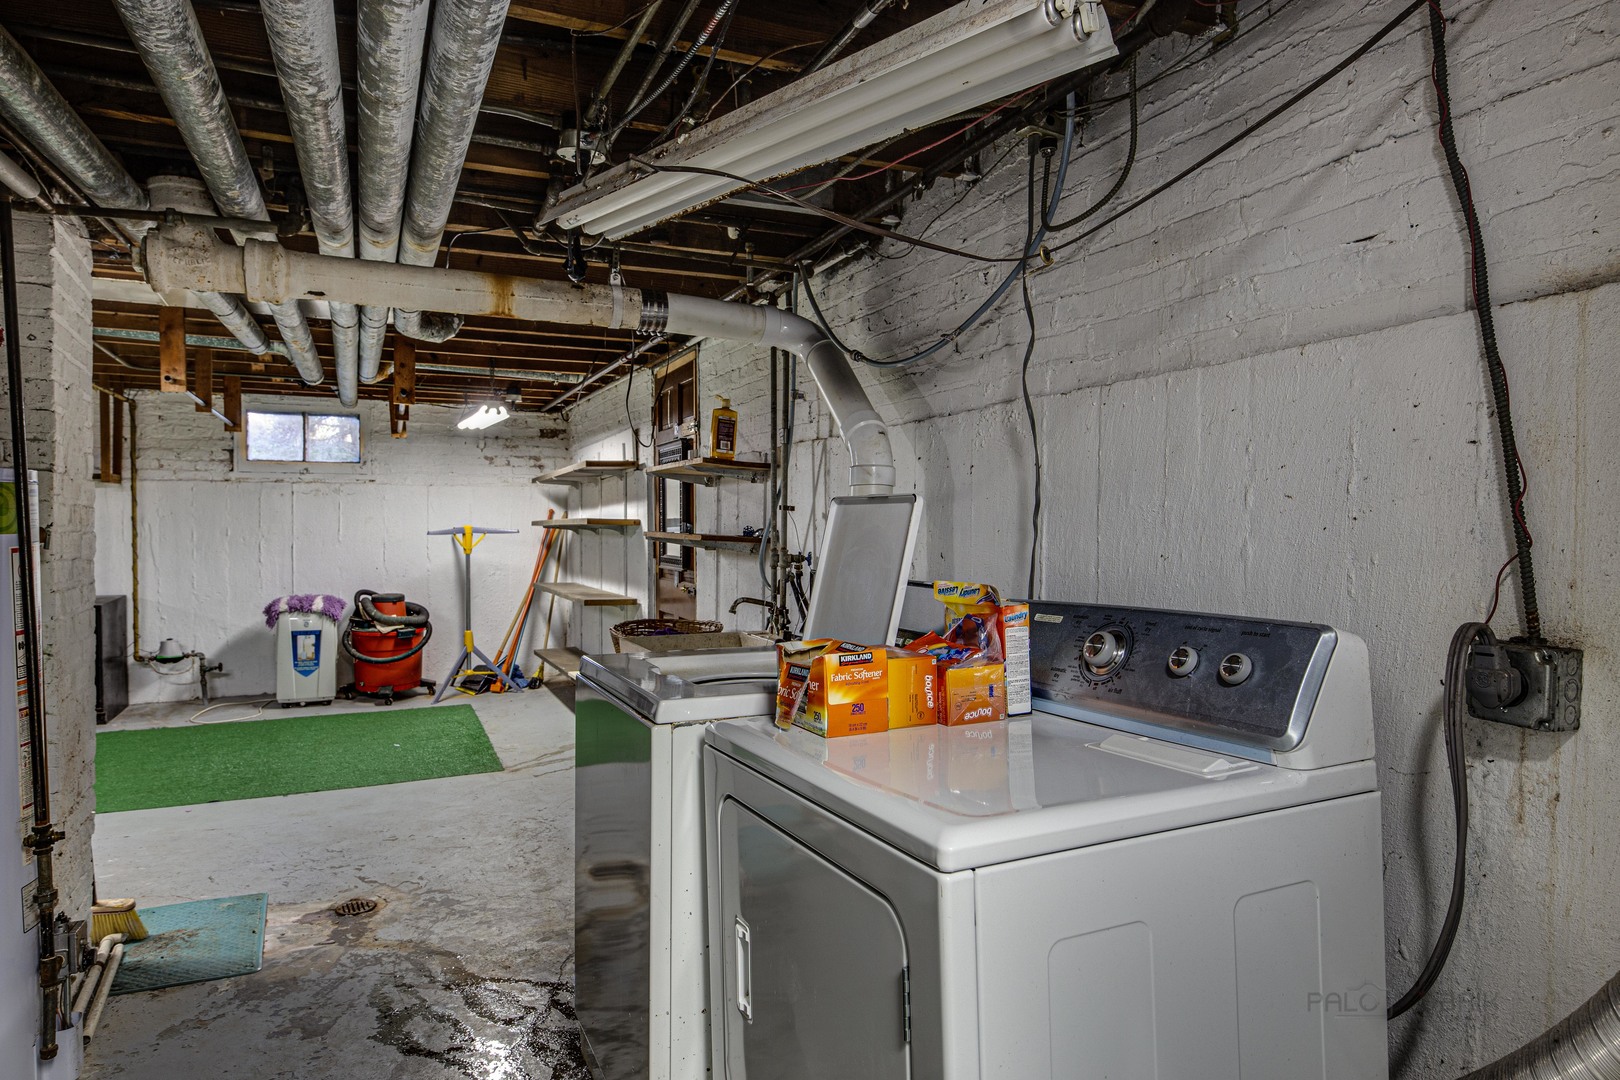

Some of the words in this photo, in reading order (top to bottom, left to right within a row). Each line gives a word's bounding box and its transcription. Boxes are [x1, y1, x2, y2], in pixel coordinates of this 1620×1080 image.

[1004, 612, 1028, 623] Laundry
[841, 653, 872, 662] KIRKLAND
[831, 672, 852, 682] Fabric
[853, 670, 883, 680] Softener
[924, 674, 934, 708] bounce
[851, 702, 865, 712] 250
[813, 710, 822, 721] 250
[964, 707, 992, 720] bounce
